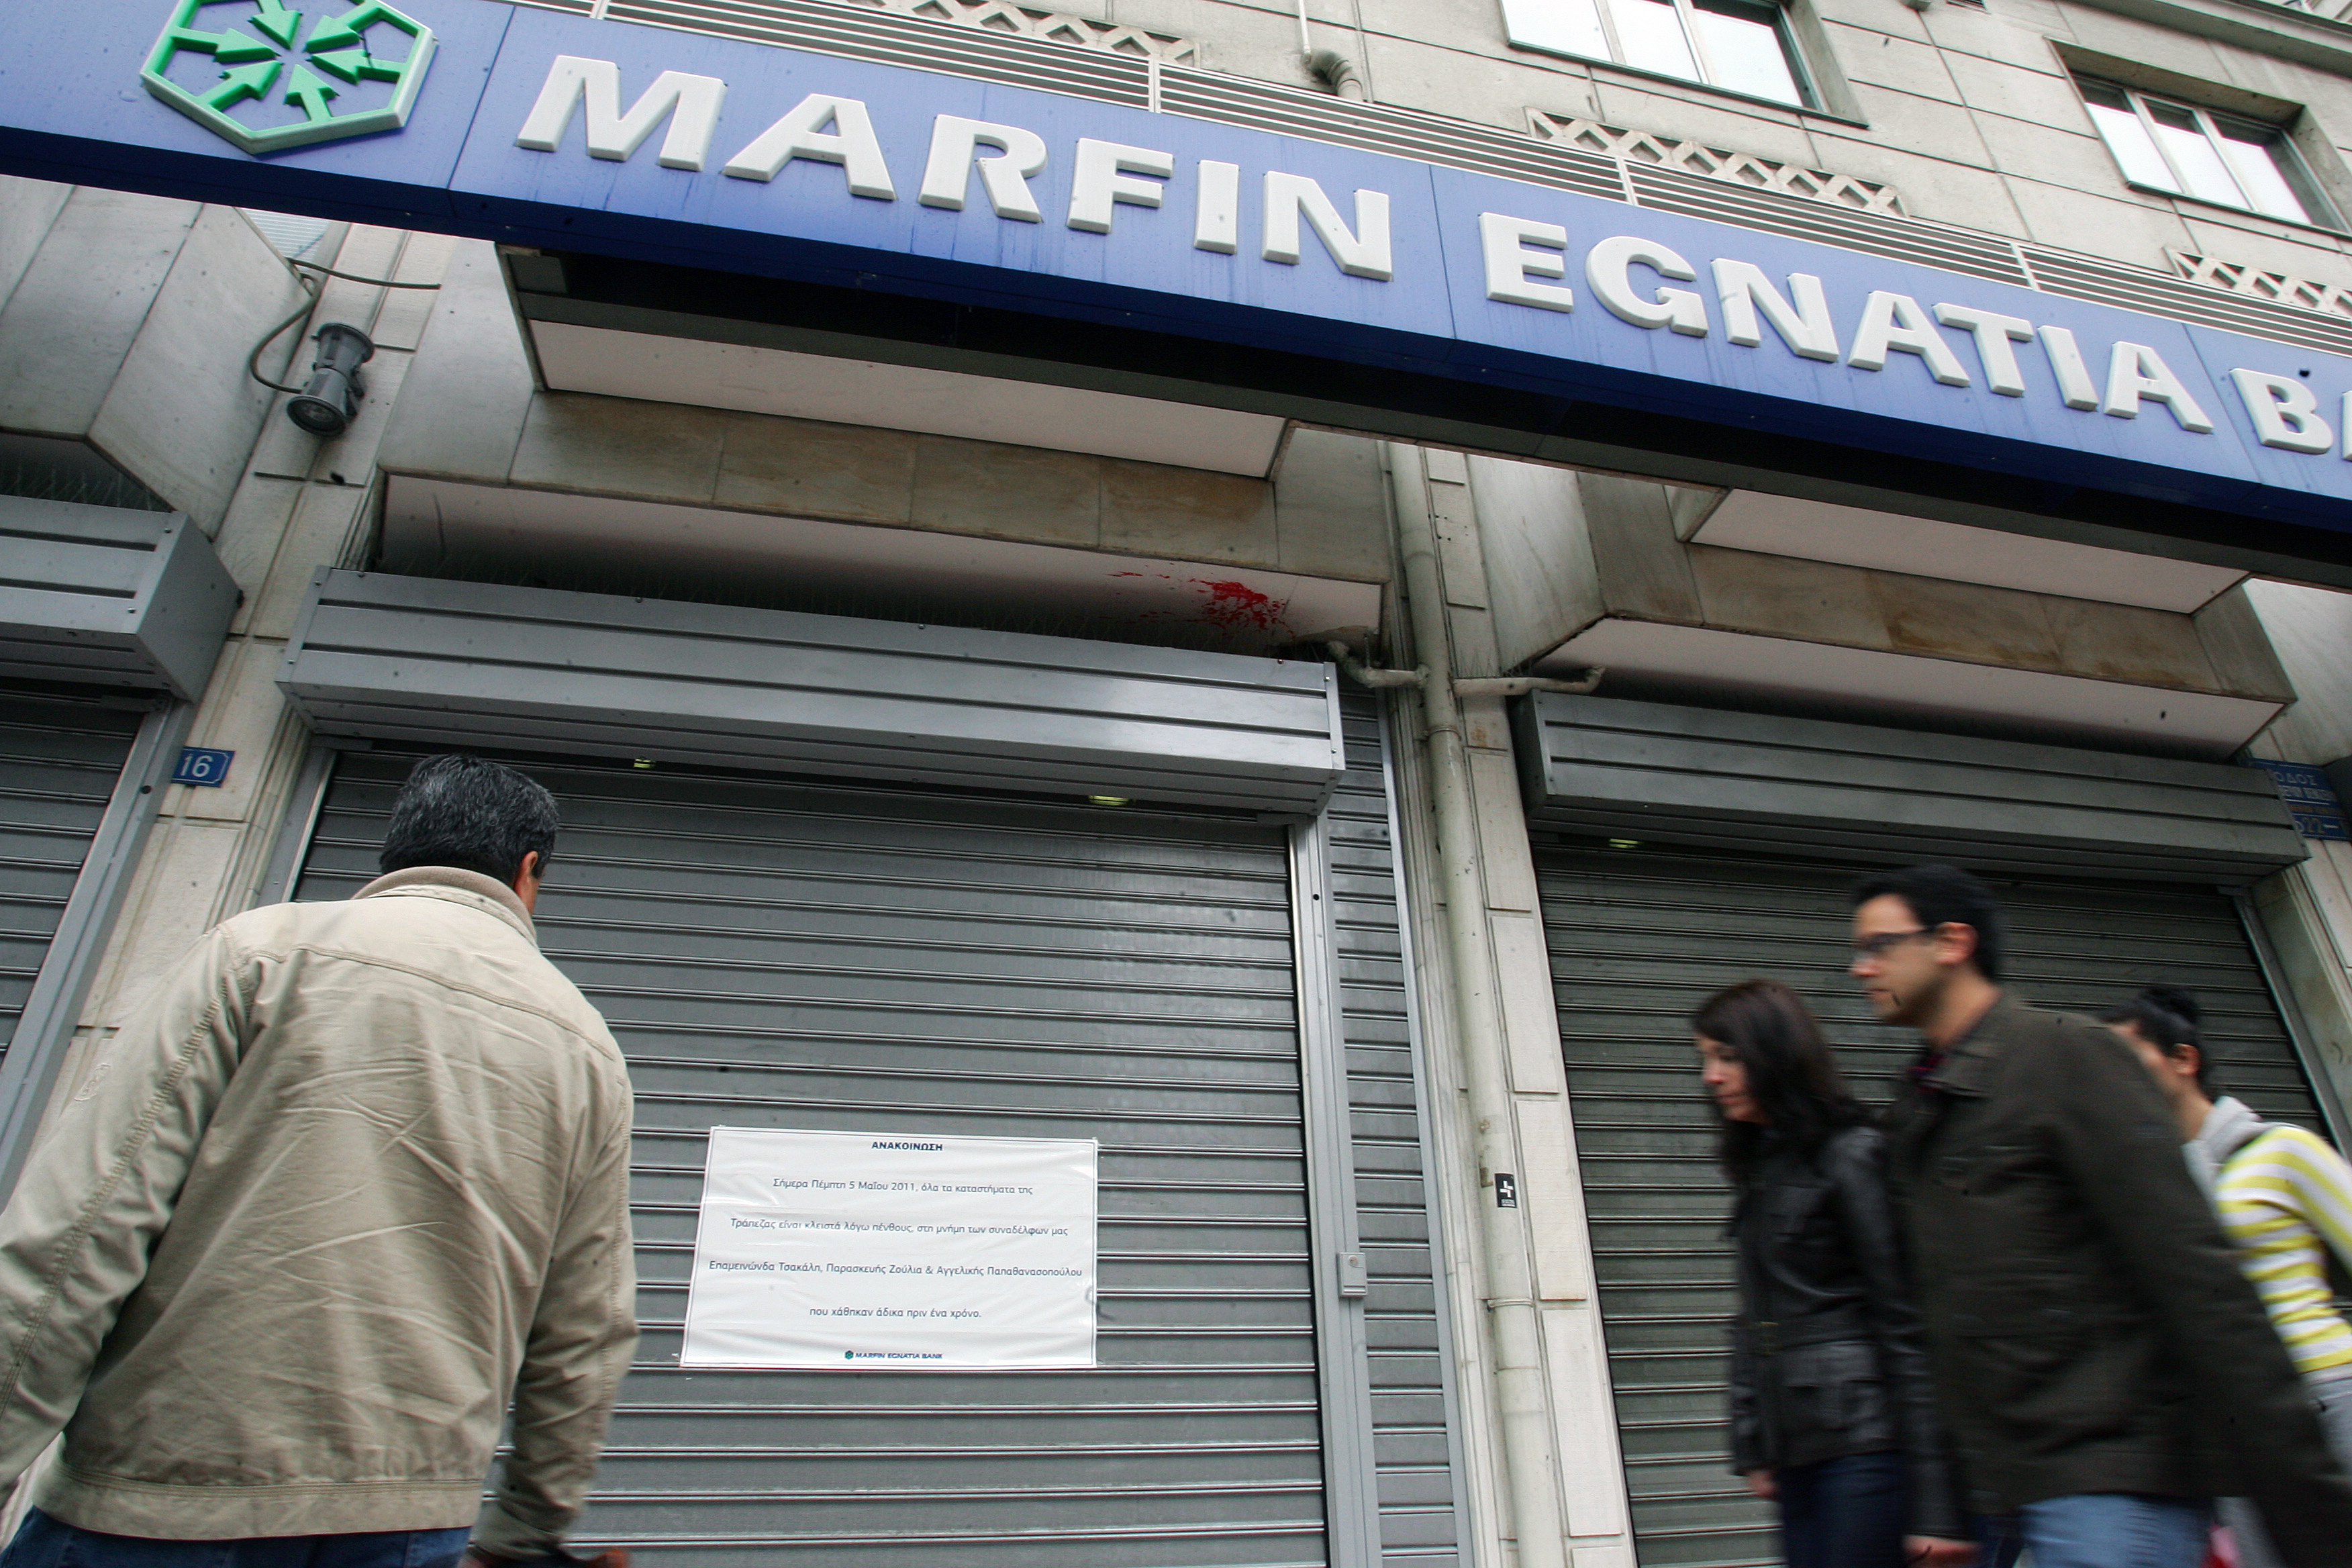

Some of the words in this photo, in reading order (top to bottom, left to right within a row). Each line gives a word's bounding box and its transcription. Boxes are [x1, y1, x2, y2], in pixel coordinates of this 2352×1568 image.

[516, 55, 1393, 282] MARFIN
[1478, 211, 2214, 434] EGNATIA
[2229, 367, 2352, 462] B
[180, 752, 213, 778] 16
[871, 1141, 943, 1151] ΑΝΑΚΟΙΝΩΣΗ
[773, 1178, 808, 1189] Σήμερα
[811, 1179, 846, 1190] Πέμπτη
[848, 1181, 855, 1189] 5
[891, 1182, 919, 1191] 2011,
[921, 1183, 939, 1191] όλα
[954, 1184, 1016, 1195] καταστήματα
[730, 1218, 776, 1229] Τράπεζας
[779, 1220, 802, 1228] είναι
[804, 1220, 841, 1230] κλειστά
[843, 1222, 869, 1232] λόγω
[936, 1224, 965, 1234] μνήμη
[988, 1225, 1049, 1236] συναδέλφων
[1051, 1228, 1069, 1236] μας
[709, 1261, 775, 1271] Επαμεινώνδα
[778, 1262, 823, 1273] Τσακάλη,
[826, 1263, 887, 1274] Παρασκευής
[889, 1265, 922, 1274] Ζούλια
[925, 1265, 934, 1274] &
[936, 1265, 984, 1277] Αγγελικής
[987, 1267, 1083, 1277] Παπαθανασοπούλου
[831, 1306, 873, 1316] χάθηκαν
[876, 1308, 903, 1317] άδικα
[906, 1310, 928, 1319] πριν
[930, 1308, 947, 1318] ένα
[950, 1309, 982, 1319] χρόνο.
